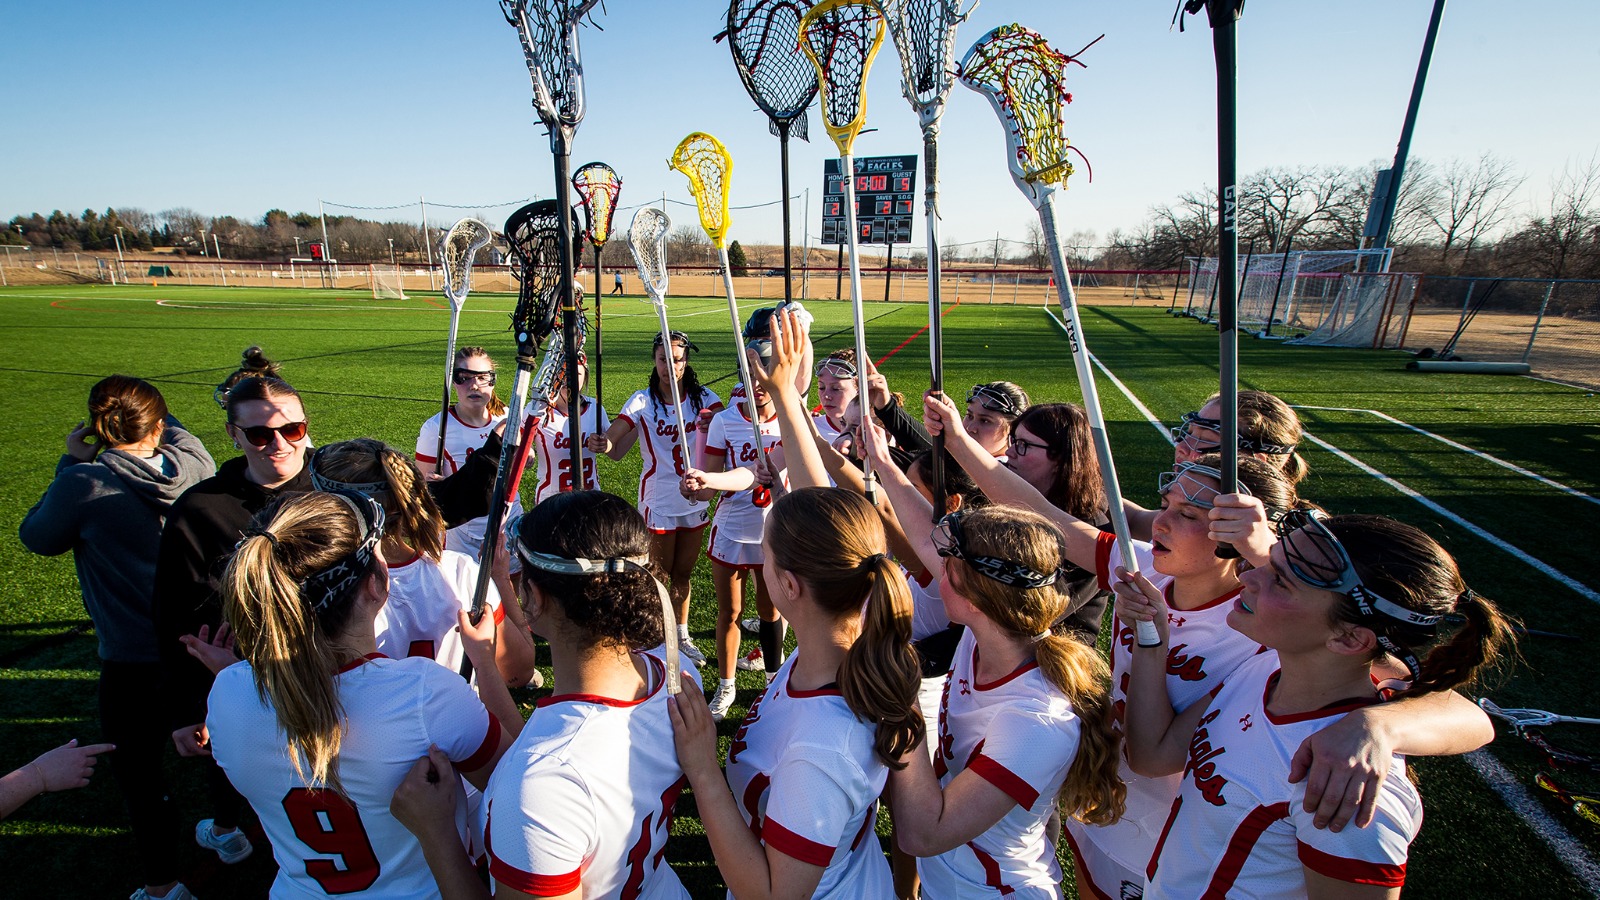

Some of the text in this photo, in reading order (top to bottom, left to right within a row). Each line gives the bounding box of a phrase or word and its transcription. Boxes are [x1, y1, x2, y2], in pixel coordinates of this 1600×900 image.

[867, 162, 903, 171] EAGLES
[901, 178, 908, 191] 5
[831, 203, 838, 215] 2
[883, 201, 890, 214] 2
[1224, 184, 1236, 233] GAIT
[863, 225, 870, 236] 2
[1064, 318, 1079, 353] GAIT
[558, 457, 595, 492] 22
[281, 787, 381, 895] 9
